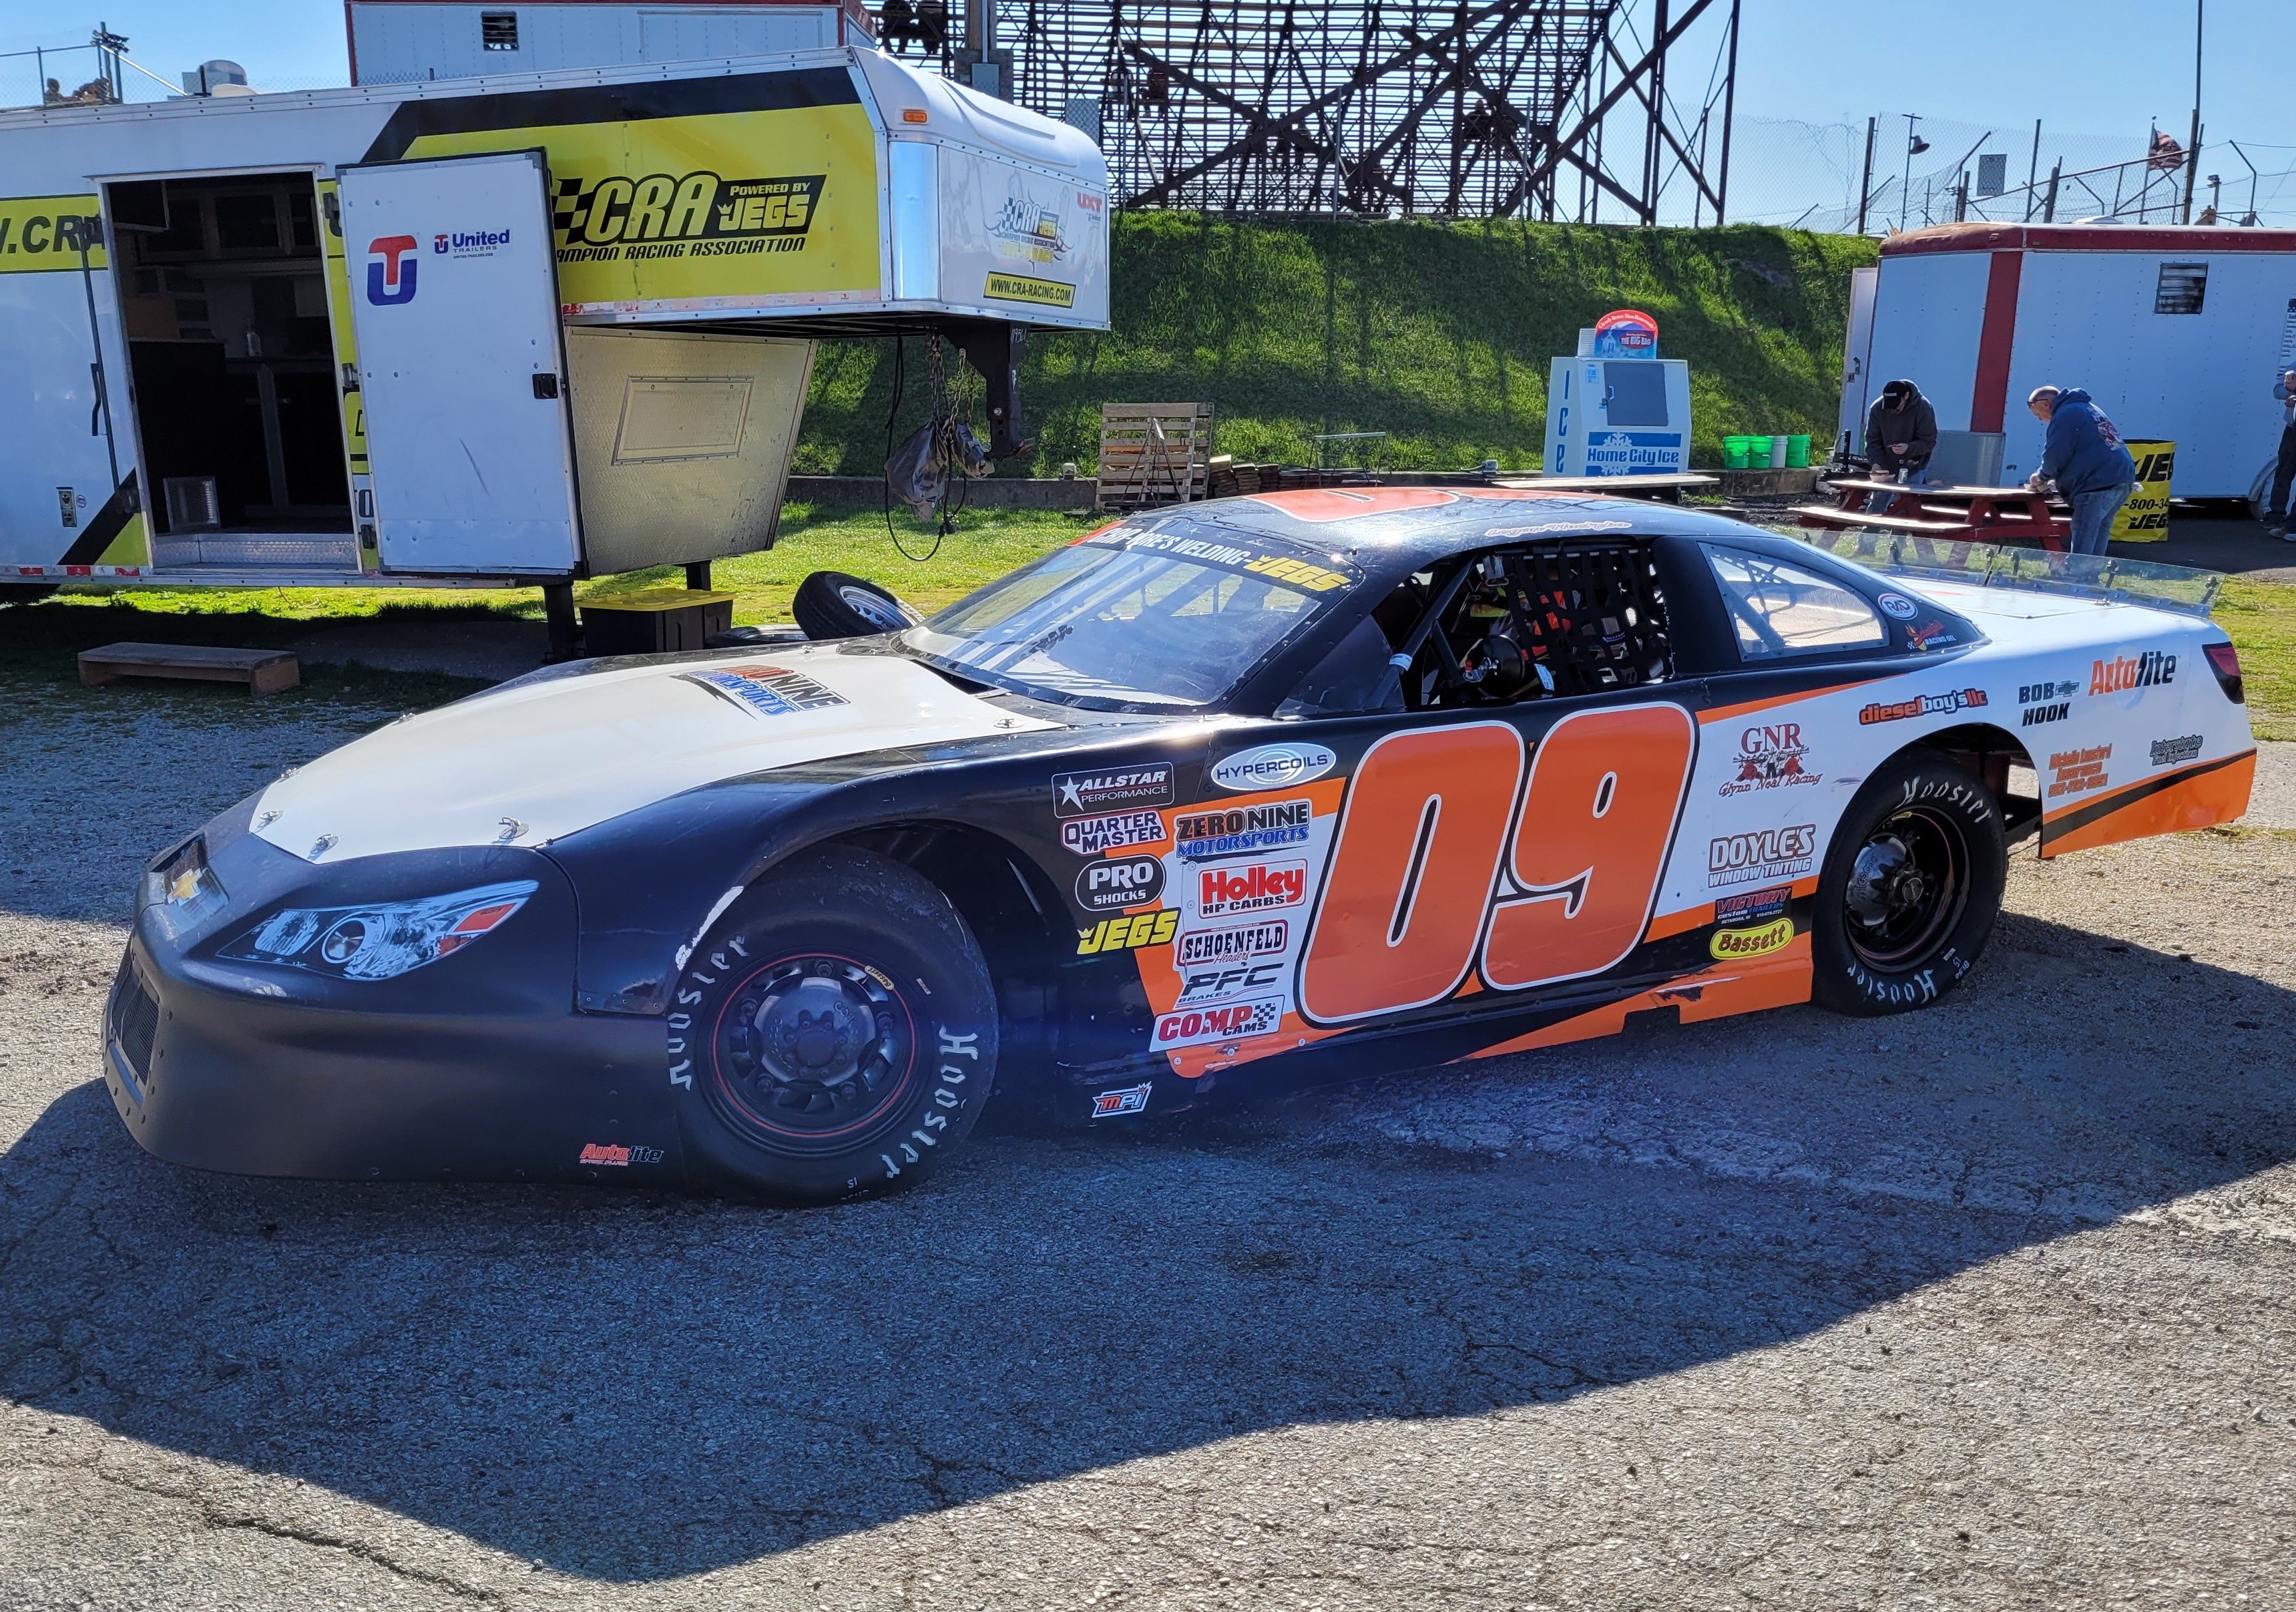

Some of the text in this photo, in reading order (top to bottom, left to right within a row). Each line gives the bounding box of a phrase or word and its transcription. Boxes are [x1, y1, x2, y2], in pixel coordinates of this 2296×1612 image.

[730, 182, 811, 197] POWERED BY
[584, 172, 720, 244] CRA
[718, 194, 811, 230] JEGS
[1011, 200, 1042, 234] CRA
[452, 229, 510, 248] United
[453, 245, 498, 254] TRAILERS
[557, 236, 806, 263] AMPION RACING ASSOCIATION
[990, 278, 1072, 302] WWW.CRA-RACING.COM
[1620, 337, 1630, 345] THE
[1630, 336, 1640, 345] BIG
[1587, 448, 1679, 465] Home City Ice
[1242, 556, 1353, 592] JEGS
[1923, 636, 1946, 646] RACING
[754, 672, 851, 711] NINE
[2018, 682, 2056, 704] BOB
[2022, 702, 2071, 727] HOOK
[1741, 723, 1803, 755] GNR
[1216, 753, 1329, 780] HYPERCOILS
[1079, 770, 1168, 791] ALLSTAR
[1718, 781, 1751, 798] Glynn
[1784, 772, 1824, 788] Racing
[1081, 785, 1168, 804] PERFORMANCE
[1064, 811, 1158, 845] QUARTER
[1176, 803, 1309, 841] ZERO NINE
[1082, 825, 1163, 853] MASTER
[1176, 826, 1310, 859] MOTORSPORTS
[1710, 824, 1816, 872] DOYLE'S
[1299, 701, 1696, 1024] 09
[1708, 857, 1812, 888] WINDOW TINTING
[1088, 862, 1154, 891] PRO
[1202, 865, 1305, 904] Holley
[1093, 889, 1146, 905] SHOCKS
[1203, 894, 1285, 914] HP CARBS
[1716, 887, 1791, 914] VICTORY
[1076, 910, 1178, 956] JEGS
[1184, 926, 1283, 961] SCHOENFELD
[1718, 924, 1786, 952] Bassett
[1213, 949, 1250, 966] Headers
[867, 966, 893, 988] Bassett
[1181, 963, 1285, 996] PFC
[1177, 990, 1231, 1004] BRAKES
[1158, 1005, 1252, 1041] COMP
[1222, 1021, 1268, 1036] CAMS
[579, 1143, 664, 1163] Autolite
